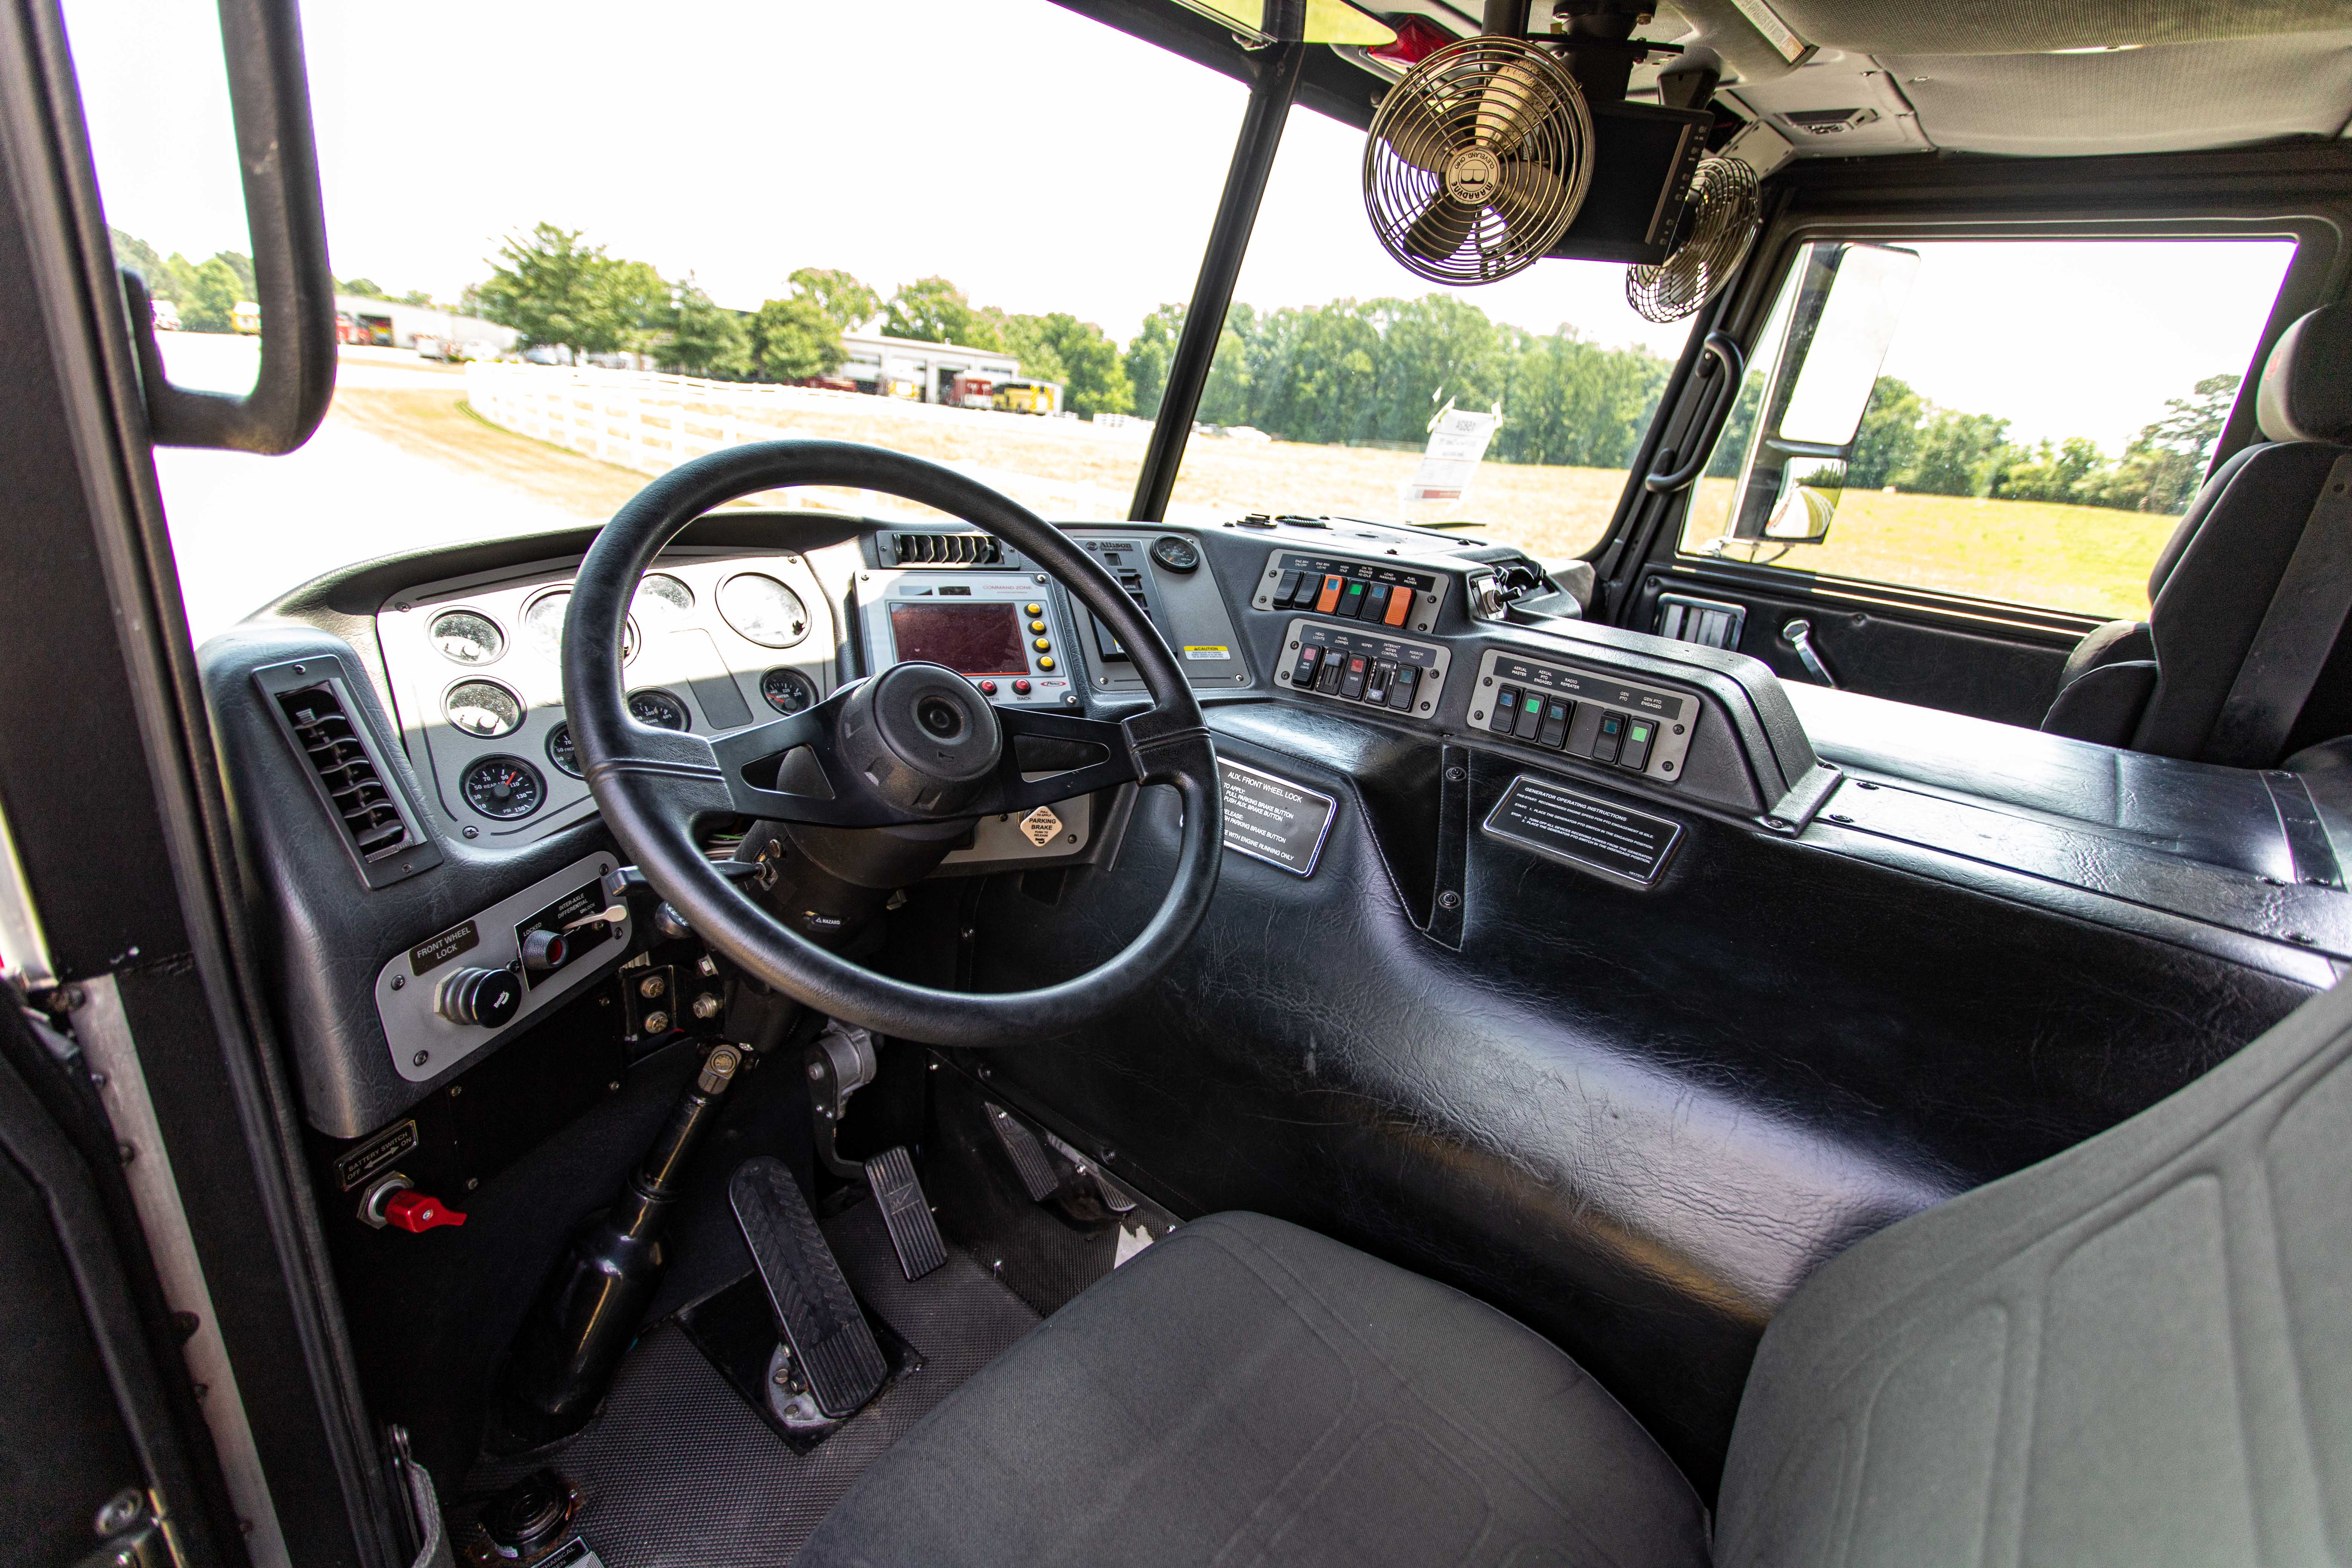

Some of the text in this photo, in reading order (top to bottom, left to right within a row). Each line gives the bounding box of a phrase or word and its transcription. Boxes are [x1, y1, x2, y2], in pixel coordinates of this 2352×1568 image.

[1455, 157, 1465, 169] OHIO
[1228, 772, 1303, 803] AUX. FRONT WHEEL LOCK
[1230, 785, 1245, 795] APPLY:
[1225, 790, 1294, 819] PULL PARKING BRAKE BUTTON
[1236, 800, 1247, 809] AUX.
[1247, 805, 1263, 816] BRAKE
[1263, 811, 1283, 822] BUTTON
[1516, 793, 1537, 802] PRE-START:
[1538, 800, 1567, 811] RECOMMENDED
[1611, 822, 1640, 834] ENGAGEMENT
[1525, 787, 1627, 821] GENERATOR OPERATING INSTRUCTIONS
[1230, 818, 1286, 844] PARKING BRAKE BUTTON
[1547, 827, 1570, 837] GENERATOR
[1607, 846, 1630, 857] DISENGAGE
[1631, 854, 1651, 864] POSITION.
[1554, 815, 1577, 825] GENERATOR
[1585, 824, 1601, 832] SWITCH
[1614, 833, 1633, 843] ENGAGED
[1634, 840, 1654, 850] POSITION.
[1554, 825, 1571, 833] DEVICES
[1571, 830, 1591, 840] RECEIVING
[1628, 849, 1653, 861] GENERATOR.
[1229, 831, 1240, 840] WITH
[1240, 836, 1258, 847] ENGINE
[1259, 843, 1280, 856] RUNNING
[1280, 852, 1294, 861] ONLY
[558, 899, 588, 919] DIFFERENTIAL
[559, 893, 584, 911] INTER-AXLE
[580, 902, 596, 914] UNLOCK
[417, 927, 471, 958] FRONT WHEEL
[523, 922, 542, 937] LOCKED
[436, 943, 457, 959] LOCK
[494, 991, 505, 1008] Bendix
[347, 1137, 412, 1180] OFF ON
[348, 1132, 407, 1172] BATTERY SWITCH
